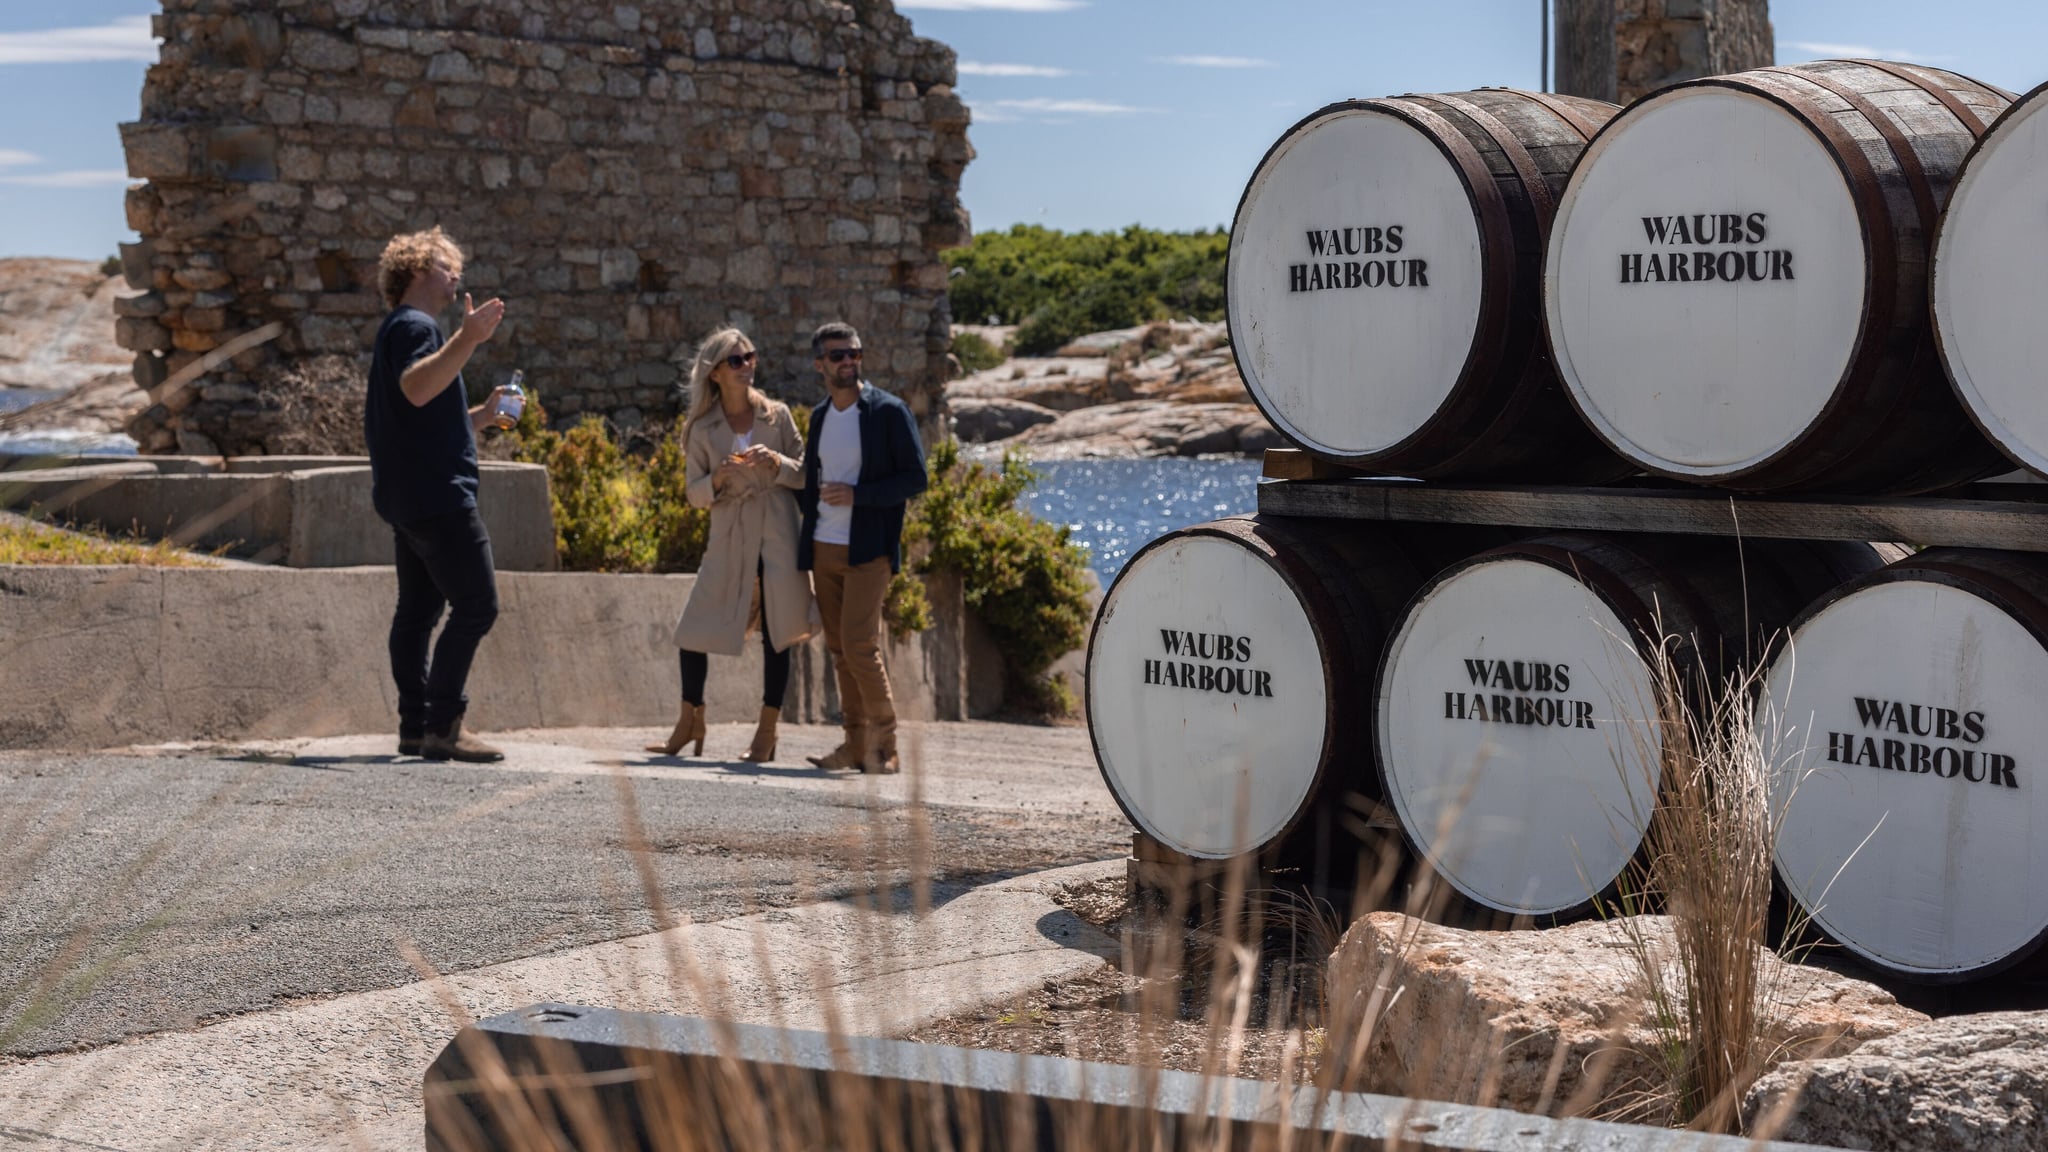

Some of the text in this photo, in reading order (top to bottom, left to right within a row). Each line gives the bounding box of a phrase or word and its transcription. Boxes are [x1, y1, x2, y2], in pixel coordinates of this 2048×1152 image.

[1306, 225, 1404, 257] WAUBS
[1641, 212, 1767, 246] WAUBS
[1289, 258, 1429, 292] HARBOUR
[1620, 249, 1795, 284] HARBOUR
[1160, 629, 1251, 662] WAUBS
[1144, 659, 1274, 697] HARBOUR
[1464, 659, 1570, 693] WAUBS
[1444, 692, 1596, 729] HARBOUR
[1854, 697, 1985, 743] WAUBS
[1827, 732, 2018, 788] HARBOUR
